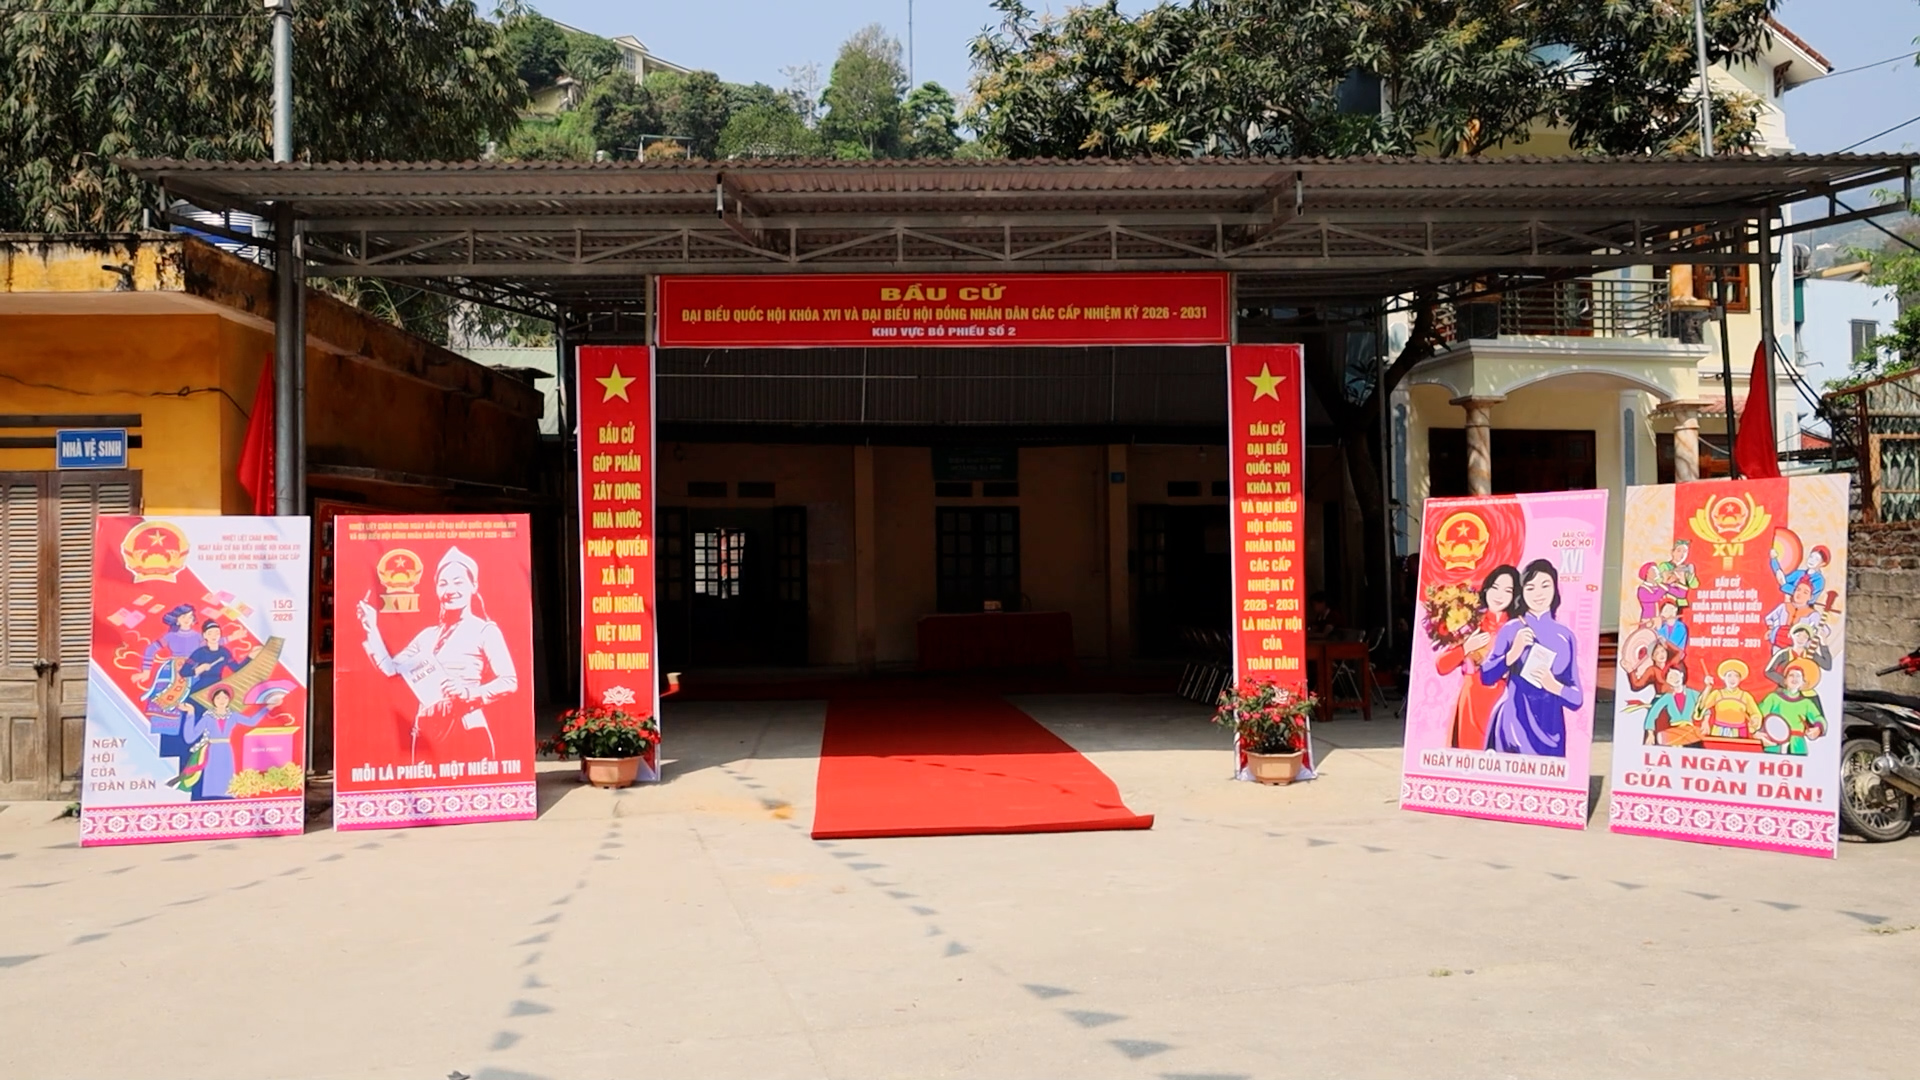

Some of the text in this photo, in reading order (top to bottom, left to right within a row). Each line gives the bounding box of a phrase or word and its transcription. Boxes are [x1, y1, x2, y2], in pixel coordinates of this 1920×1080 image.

[881, 283, 1007, 301] BẦU CỬ
[682, 308, 701, 324] ĐẠI
[704, 305, 730, 321] BIỂU
[734, 306, 764, 322] QUỐC
[767, 307, 786, 324] HỘI
[789, 307, 820, 321] KHÓA
[823, 309, 841, 321] XVI
[844, 307, 859, 321] VÀ
[862, 308, 881, 324] ĐẠI
[884, 304, 910, 321] BIỂU
[913, 307, 932, 323] HỘI
[936, 304, 967, 320] ĐỒNG
[970, 305, 1001, 320] NHÂN
[1005, 305, 1029, 320] DÂN
[1032, 306, 1055, 320] CÁC
[1058, 303, 1080, 320] CẤP
[1084, 305, 1121, 322] NHIỆM
[1124, 305, 1139, 319] KỲ
[1142, 307, 1169, 319] 2026
[1180, 306, 1207, 319] 2031
[872, 324, 1016, 338] KHU VỰC BỎ PHIẾU SỐ 2
[599, 421, 635, 444] BẦU CỬ
[1249, 420, 1286, 436] BẦU CỬ
[62, 437, 122, 461] NHÀ VỆ SINH
[1247, 438, 1288, 458] ĐẠI BIỂU
[592, 449, 641, 472] GÓP PHẦN
[1246, 459, 1291, 477] QUỐC HỘI
[593, 480, 641, 504] XÂY DỰNG
[1246, 480, 1291, 494] KHÓA XVI
[1241, 497, 1297, 516] VÀ ĐẠI BIỂU
[592, 508, 642, 528] NHÀ NƯỚC
[1247, 517, 1292, 536] HỘI ĐỒNG
[587, 534, 648, 558] PHÁP QUYỀN
[1245, 538, 1295, 552] NHÂN DÂN
[1712, 543, 1744, 557] XVI
[1249, 555, 1291, 572] CÁC CẤP
[1560, 549, 1584, 574] XVI
[601, 564, 634, 588] XÃ HỘI
[1248, 576, 1295, 594] NHIỆM KỲ
[380, 593, 420, 613] XVI
[592, 591, 644, 613] CHỦ NGHĨA
[1243, 599, 1268, 611] 2026
[1276, 599, 1299, 611] 2031
[595, 622, 641, 645] VIỆT NAM
[1242, 615, 1302, 633] LÀ NGÀY HỘI
[1262, 634, 1283, 651] CỦA
[588, 650, 649, 673] VỮNG MẠNH!
[1247, 655, 1299, 670] TOÀN DÂN!
[92, 737, 127, 748] NGÀY
[91, 752, 115, 764] HỘI
[1423, 751, 1566, 778] NGÀY HỘI CỦA TOÀN DÂN
[1644, 750, 1804, 780] LÀ NGÀY HỘI
[90, 766, 116, 777] CỦA
[352, 763, 375, 782] MỖI
[397, 760, 436, 780] PHIẾU,
[439, 762, 465, 779] MỘT
[501, 760, 521, 774] TIN
[90, 778, 156, 791] TOÀN DÂN
[1624, 768, 1823, 803] CỦA TOÀN DÂN!
